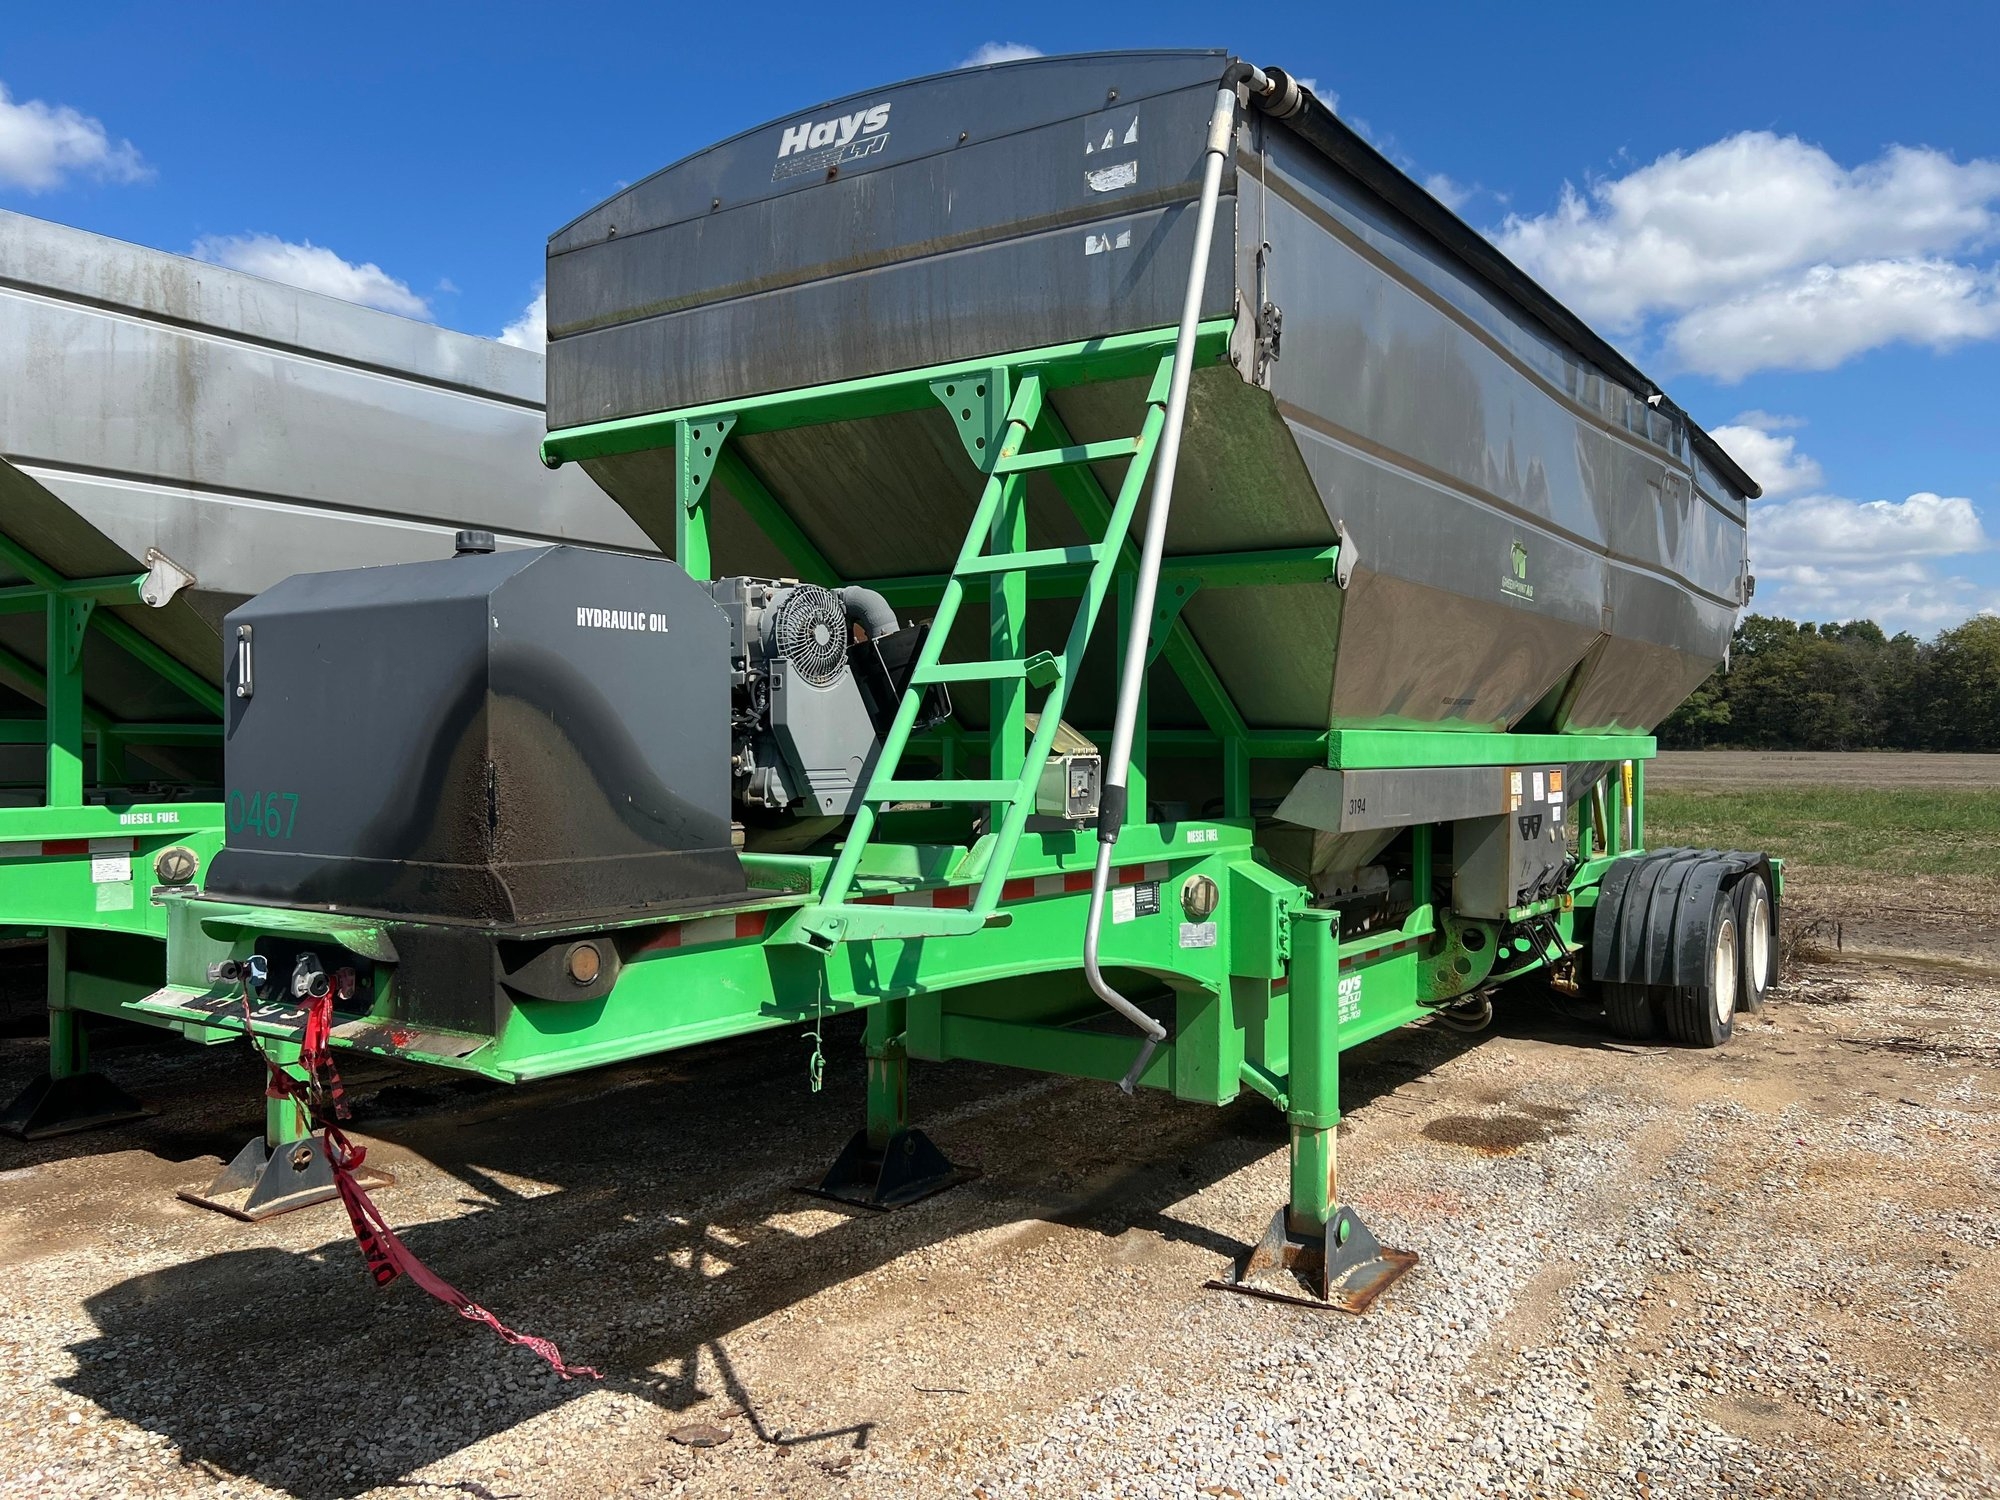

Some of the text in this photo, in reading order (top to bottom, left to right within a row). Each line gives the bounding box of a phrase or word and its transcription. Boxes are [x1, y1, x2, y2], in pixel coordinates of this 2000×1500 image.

[777, 102, 891, 159] Hays
[577, 607, 669, 632] HYDRAULIC OIL
[228, 789, 298, 839] 0467
[1349, 798, 1366, 815] 3194
[120, 812, 180, 825] DIESEL FUEL
[1186, 829, 1219, 844] DIESEL FUEL
[1338, 974, 1362, 996] ays
